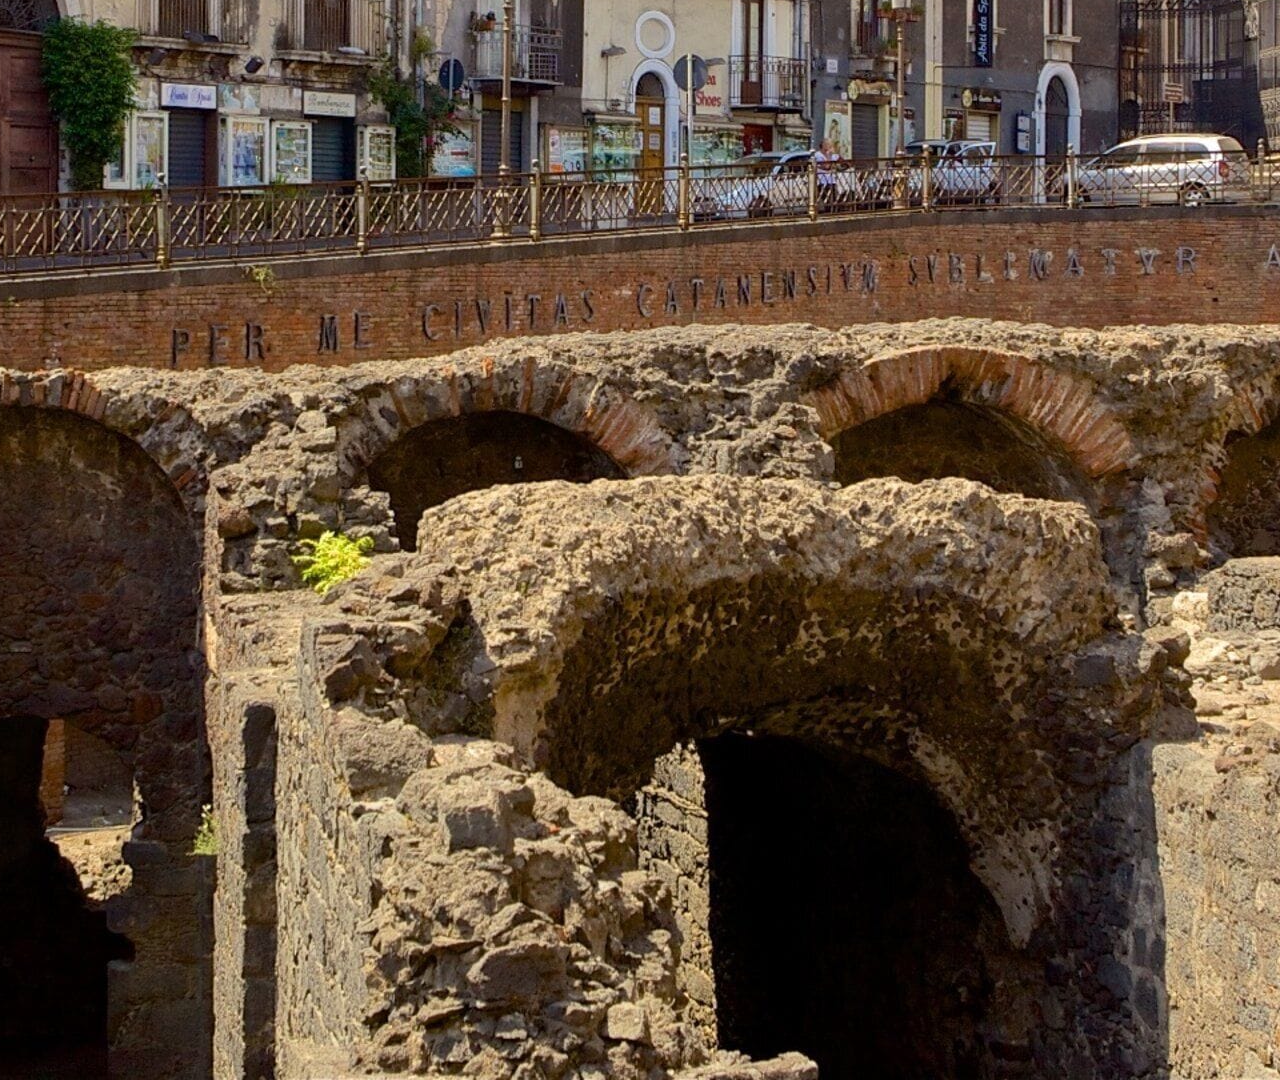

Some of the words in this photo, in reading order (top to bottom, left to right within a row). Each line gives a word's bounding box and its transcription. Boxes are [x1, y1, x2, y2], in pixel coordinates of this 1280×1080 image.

[979, 16, 987, 31] da
[977, 33, 988, 63] Abiti
[171, 322, 265, 368] PER
[318, 312, 373, 353] ME
[421, 287, 595, 341] CIVITAS
